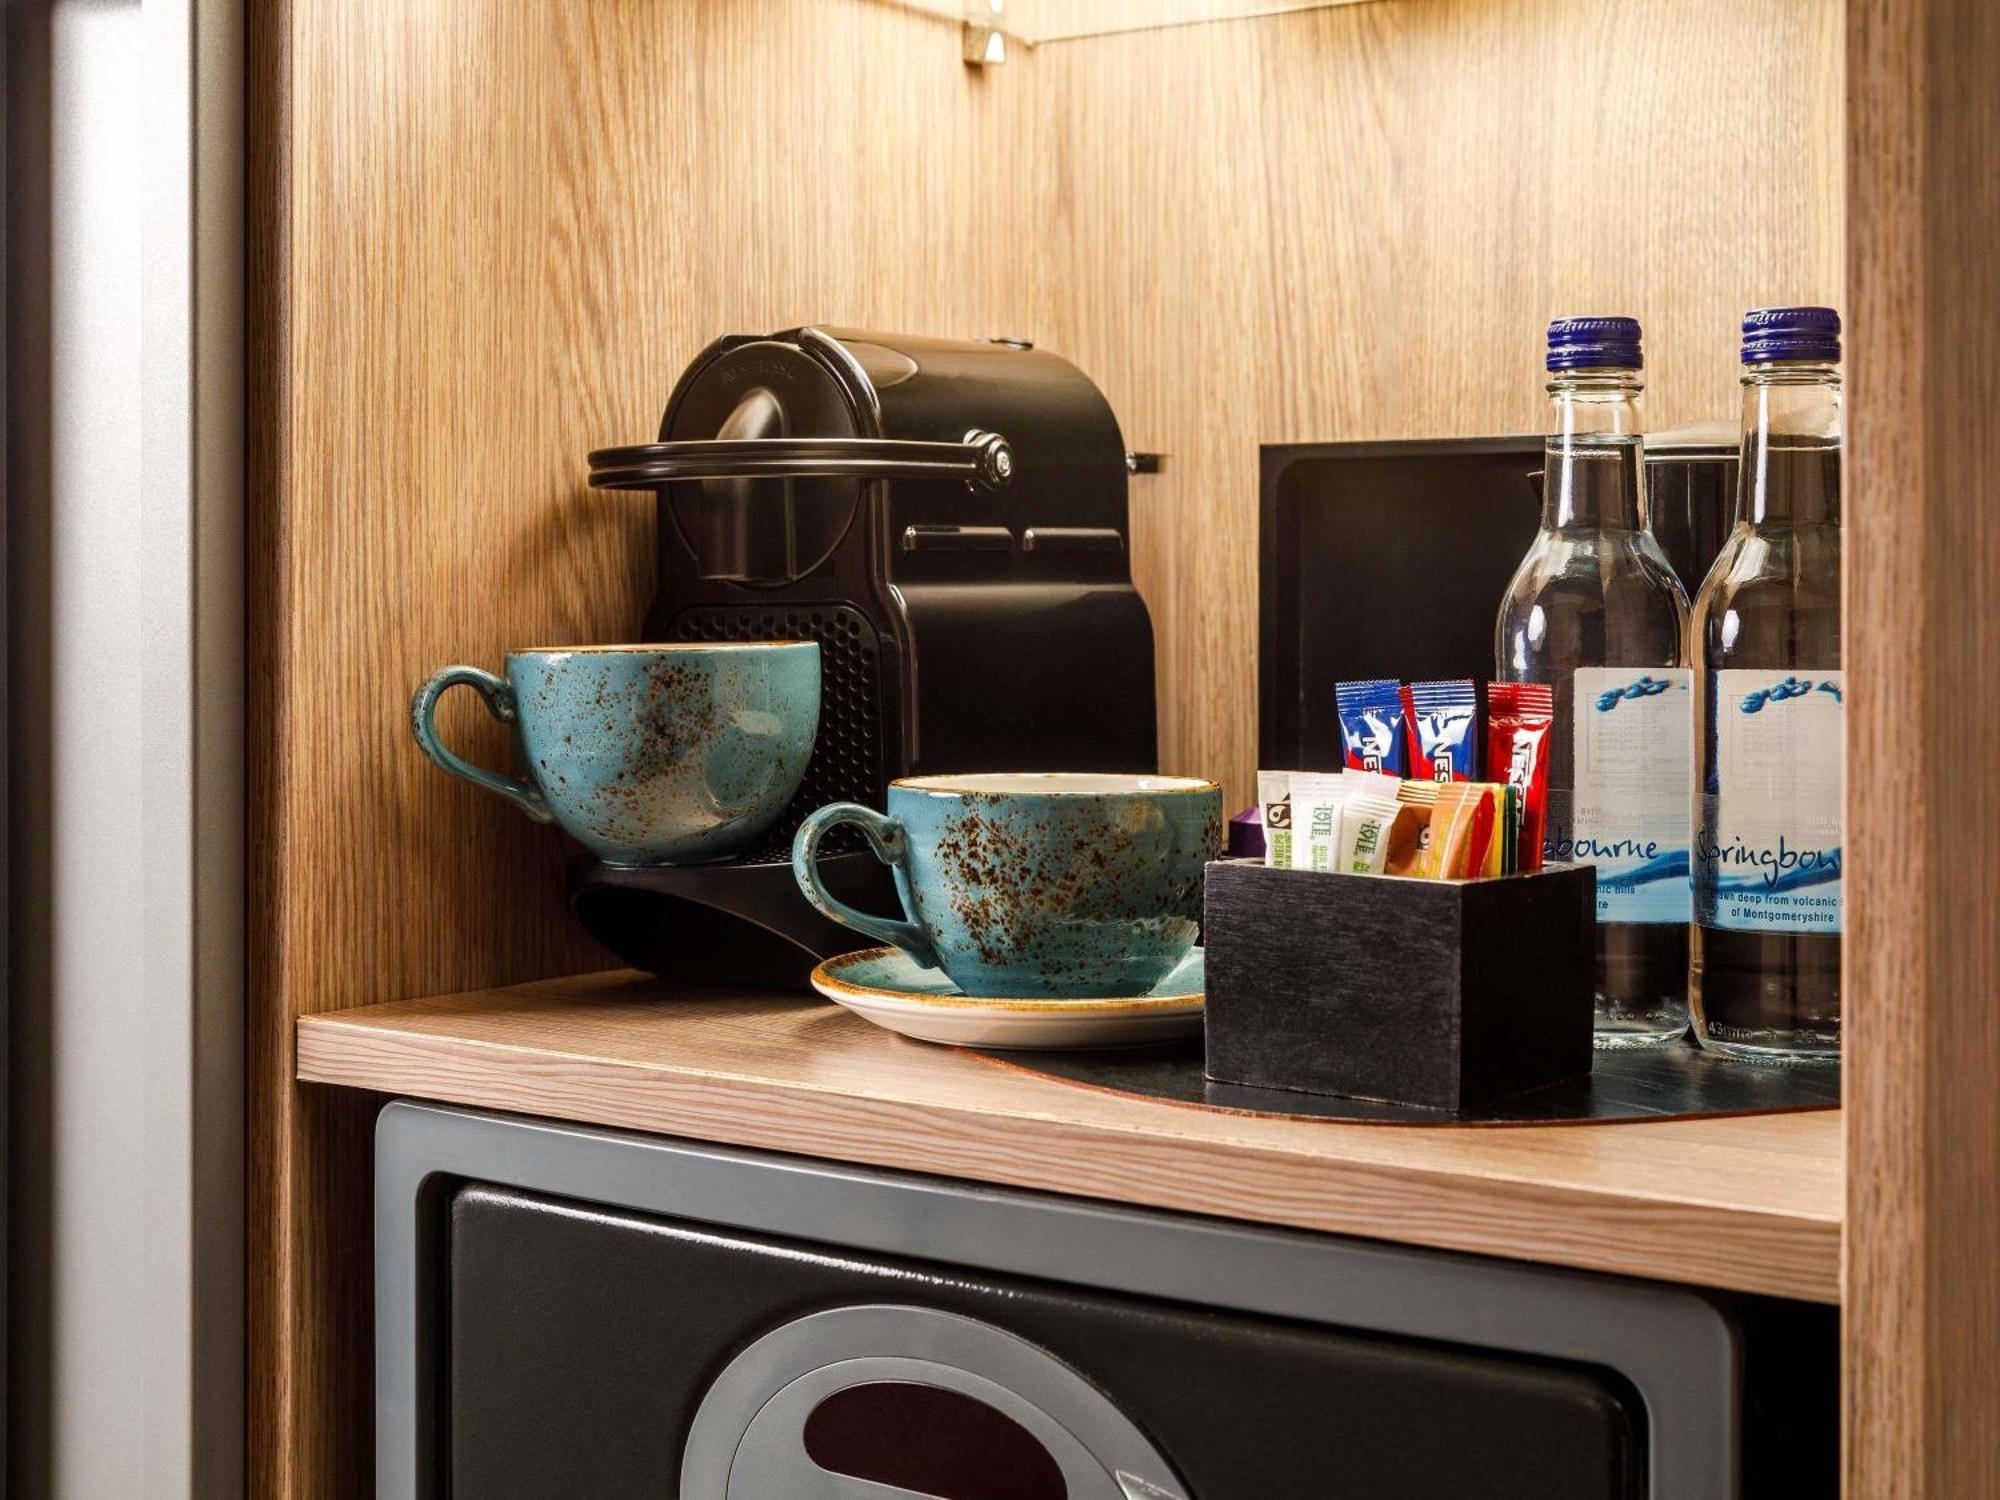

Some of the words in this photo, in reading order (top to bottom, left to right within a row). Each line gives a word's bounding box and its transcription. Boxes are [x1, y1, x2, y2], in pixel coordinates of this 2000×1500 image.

[1738, 892, 1762, 905] deep
[1765, 894, 1789, 905] from
[1793, 896, 1837, 907] volcanic
[1731, 907, 1741, 917] of
[1743, 908, 1835, 924] Montgomeryshire
